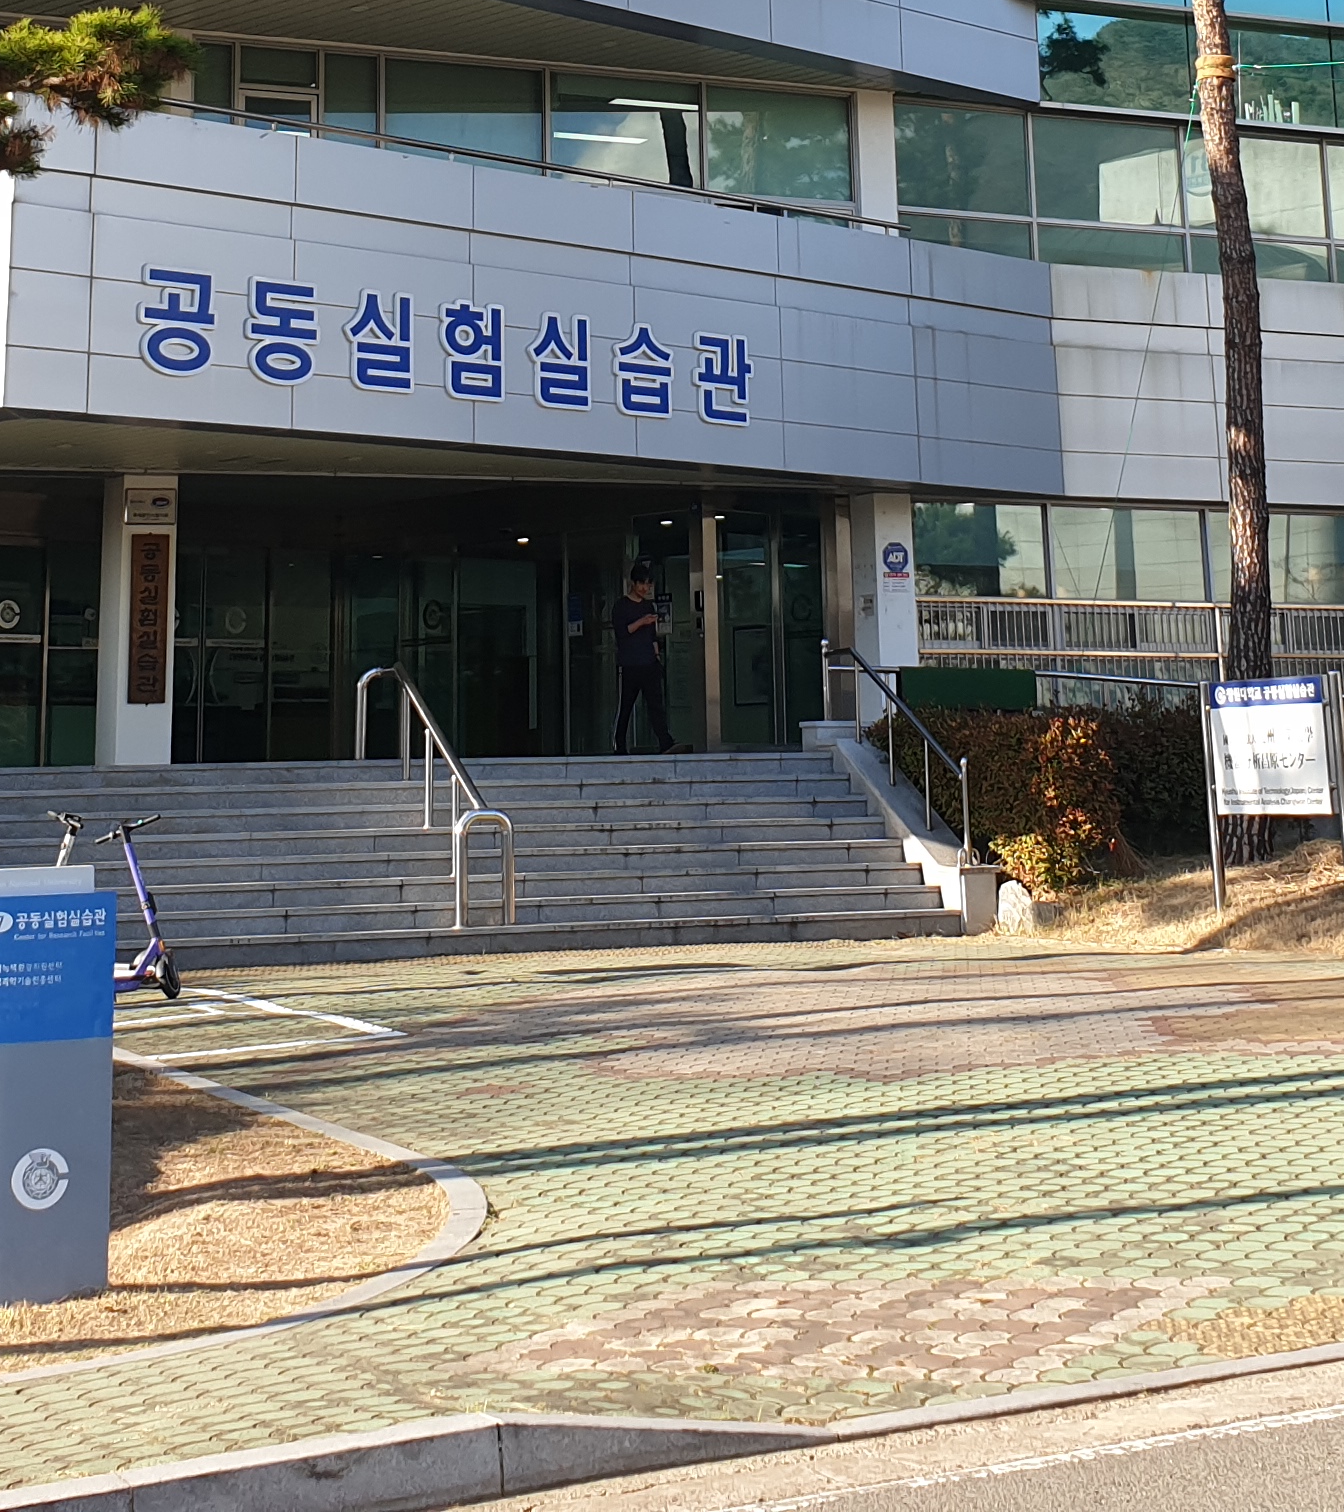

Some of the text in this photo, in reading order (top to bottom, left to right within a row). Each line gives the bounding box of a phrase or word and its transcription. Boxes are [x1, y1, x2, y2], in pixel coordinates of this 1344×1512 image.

[138, 264, 754, 426] 공동실험실습관
[887, 551, 905, 563] ADT
[15, 907, 107, 931] 공동실험실습관
